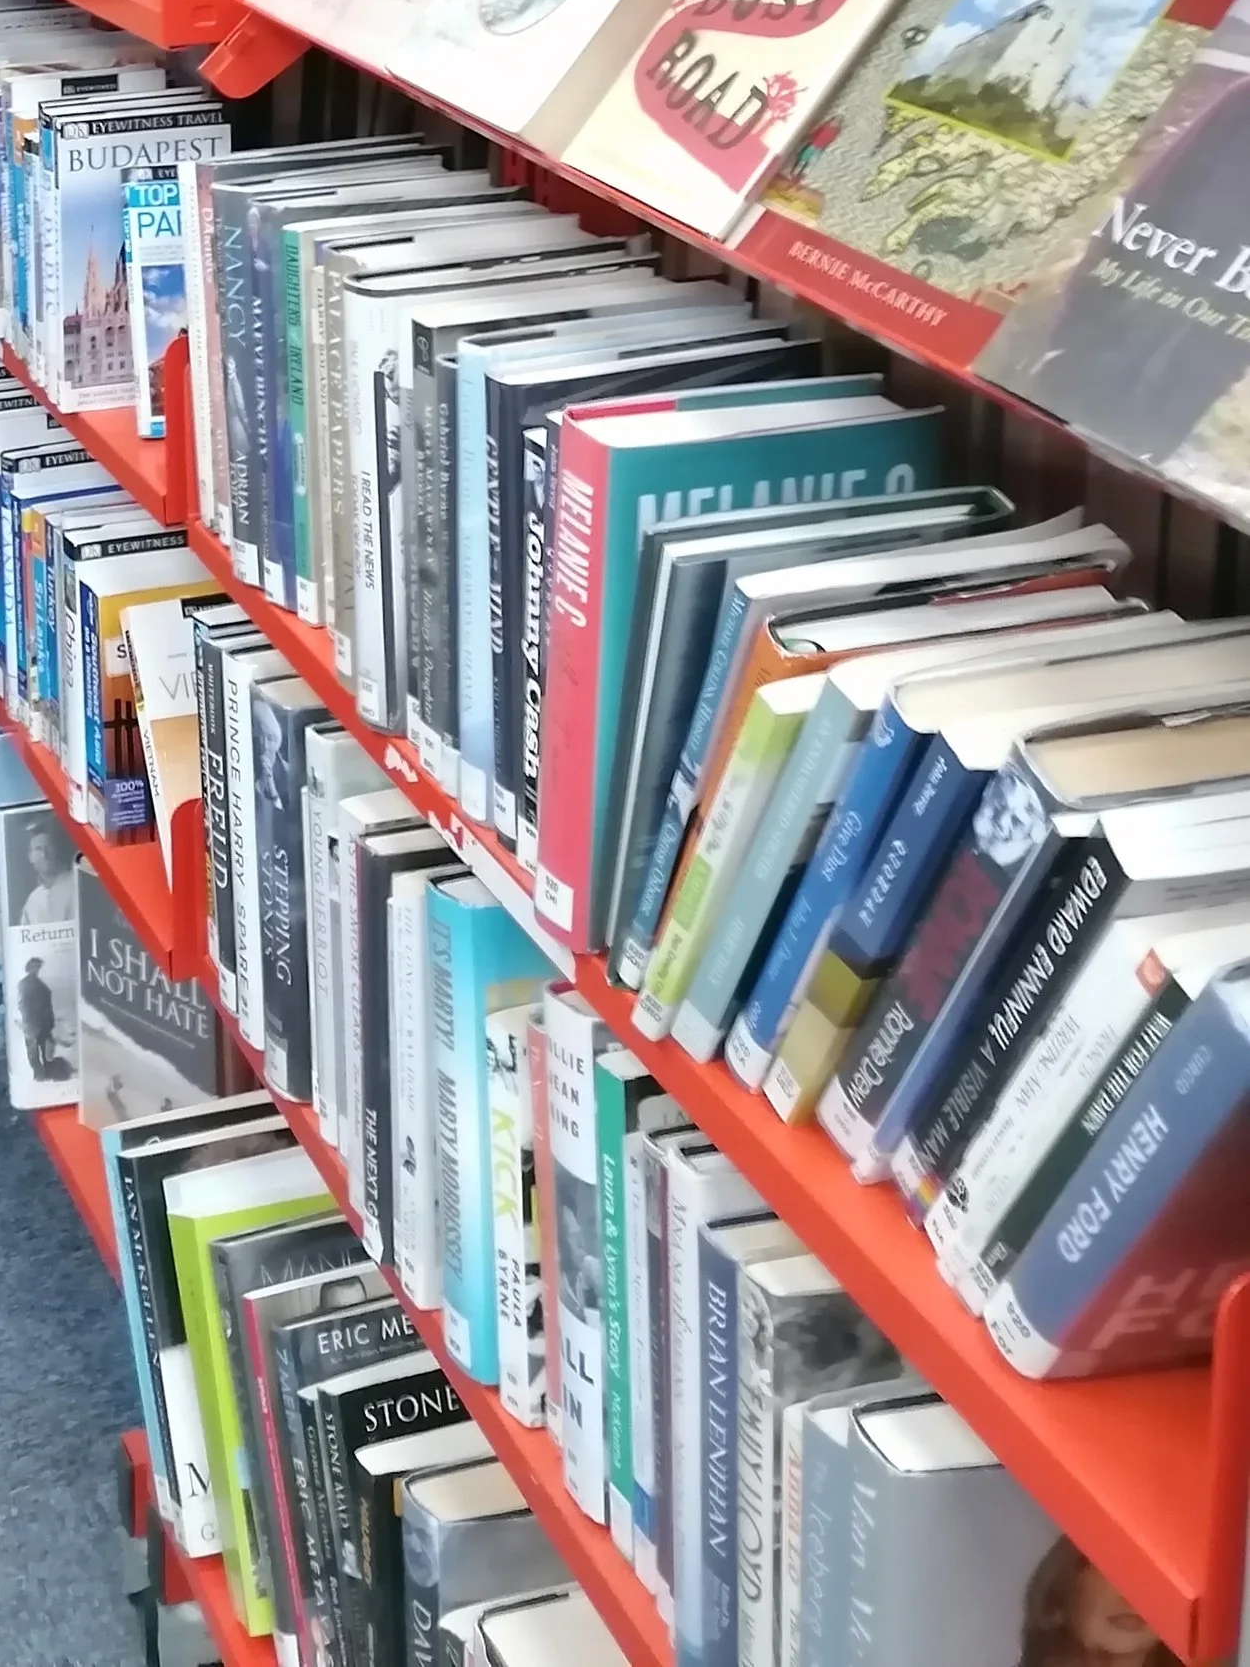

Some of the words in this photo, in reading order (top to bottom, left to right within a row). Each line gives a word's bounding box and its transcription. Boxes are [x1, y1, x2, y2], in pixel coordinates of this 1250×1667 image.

[91, 116, 173, 135] EYEWITNESS
[177, 112, 224, 127] TRAVEL
[646, 31, 770, 148] ROAD
[69, 137, 222, 172] BUDAPEST
[137, 185, 178, 206] TOP
[1093, 197, 1217, 276] Never
[224, 225, 247, 348] NANCY
[285, 245, 301, 325] DAUGHTERS
[789, 240, 850, 282] BERNIE
[850, 271, 949, 330] McCARTHY
[1092, 257, 1121, 287] My
[1124, 269, 1162, 300] Life
[1158, 285, 1185, 308] in
[1184, 297, 1227, 328] Our
[252, 296, 266, 368] MAEVE
[327, 270, 343, 396] PALACE
[289, 346, 304, 406] IRELAND
[318, 342, 328, 406] BOLAND
[254, 371, 269, 460] BINCHY
[439, 403, 450, 465] Gabriel
[235, 451, 249, 525] ADRIAN
[330, 406, 344, 516] PAPERS
[440, 471, 449, 520] Byrne
[362, 479, 372, 517] READ
[364, 520, 375, 546] THE
[1, 511, 15, 625] CANADA
[107, 534, 185, 554] EYEWITNESS
[365, 549, 375, 589] NEWS
[559, 468, 594, 602] MELANIE
[47, 566, 55, 633] Turkey
[422, 588, 432, 652] History's
[490, 582, 503, 654] MIND
[521, 512, 545, 676] Johnny
[555, 594, 588, 629] C
[36, 610, 48, 674] Lanka
[65, 613, 76, 688] China
[89, 631, 100, 721] Southeast
[422, 656, 434, 724] Daughter
[143, 732, 161, 798] VIETNAM
[227, 678, 241, 787] PRINCE
[523, 680, 543, 779] Cash
[113, 779, 144, 794] 100%
[208, 745, 229, 890] FREUD
[233, 797, 247, 888] HARRY
[312, 808, 324, 894] YOUNG
[821, 844, 849, 883] Dust
[837, 810, 864, 847] Give
[21, 927, 75, 944] Return
[273, 844, 292, 986] STEPPING
[349, 898, 360, 968] SMOKE
[433, 914, 452, 963] IT'S
[1048, 855, 1108, 957] EDWARD
[90, 927, 99, 959] I
[236, 903, 249, 982] SPARE
[313, 897, 329, 1001] HERRIOT
[88, 960, 138, 1002] NOT
[145, 987, 209, 1039] HATE
[434, 965, 456, 1052] MARTY!
[869, 1001, 915, 1068] Ronnie
[987, 946, 1056, 1052] ENNINFUL
[438, 1067, 458, 1141] MARTY
[847, 1059, 885, 1110] Drew
[939, 1061, 989, 1133] VISIBLE
[1081, 1088, 1120, 1137] DAWN
[364, 1108, 377, 1146] THE
[918, 1119, 952, 1169] MAN
[1102, 1102, 1170, 1204] HENRY
[124, 1176, 138, 1220] IAN
[365, 1149, 378, 1195] NEXT
[492, 1106, 518, 1231] KICK
[601, 1153, 616, 1219] Laura
[440, 1140, 463, 1282] MORRISSEY
[1057, 1184, 1114, 1265] FORD
[497, 1247, 510, 1323] BYRNE
[510, 1257, 523, 1328] PAULA
[604, 1238, 620, 1312] Lynn's
[317, 1322, 370, 1356] ERIC
[605, 1315, 622, 1380] Story
[705, 1279, 730, 1395] BRIAN
[1005, 1299, 1032, 1339] 920
[363, 1384, 459, 1433] STONE
[739, 1377, 771, 1486] EMILY
[279, 1371, 299, 1435] MEN
[292, 1456, 313, 1522] ERIC
[322, 1412, 343, 1482] STONE
[334, 1484, 351, 1531] MAD
[707, 1398, 731, 1559] LENIHAN
[785, 1443, 801, 1540] Anna
[739, 1486, 765, 1603] LLOYD
[788, 1542, 801, 1582] Lo
[807, 1502, 833, 1638] Iceberg
